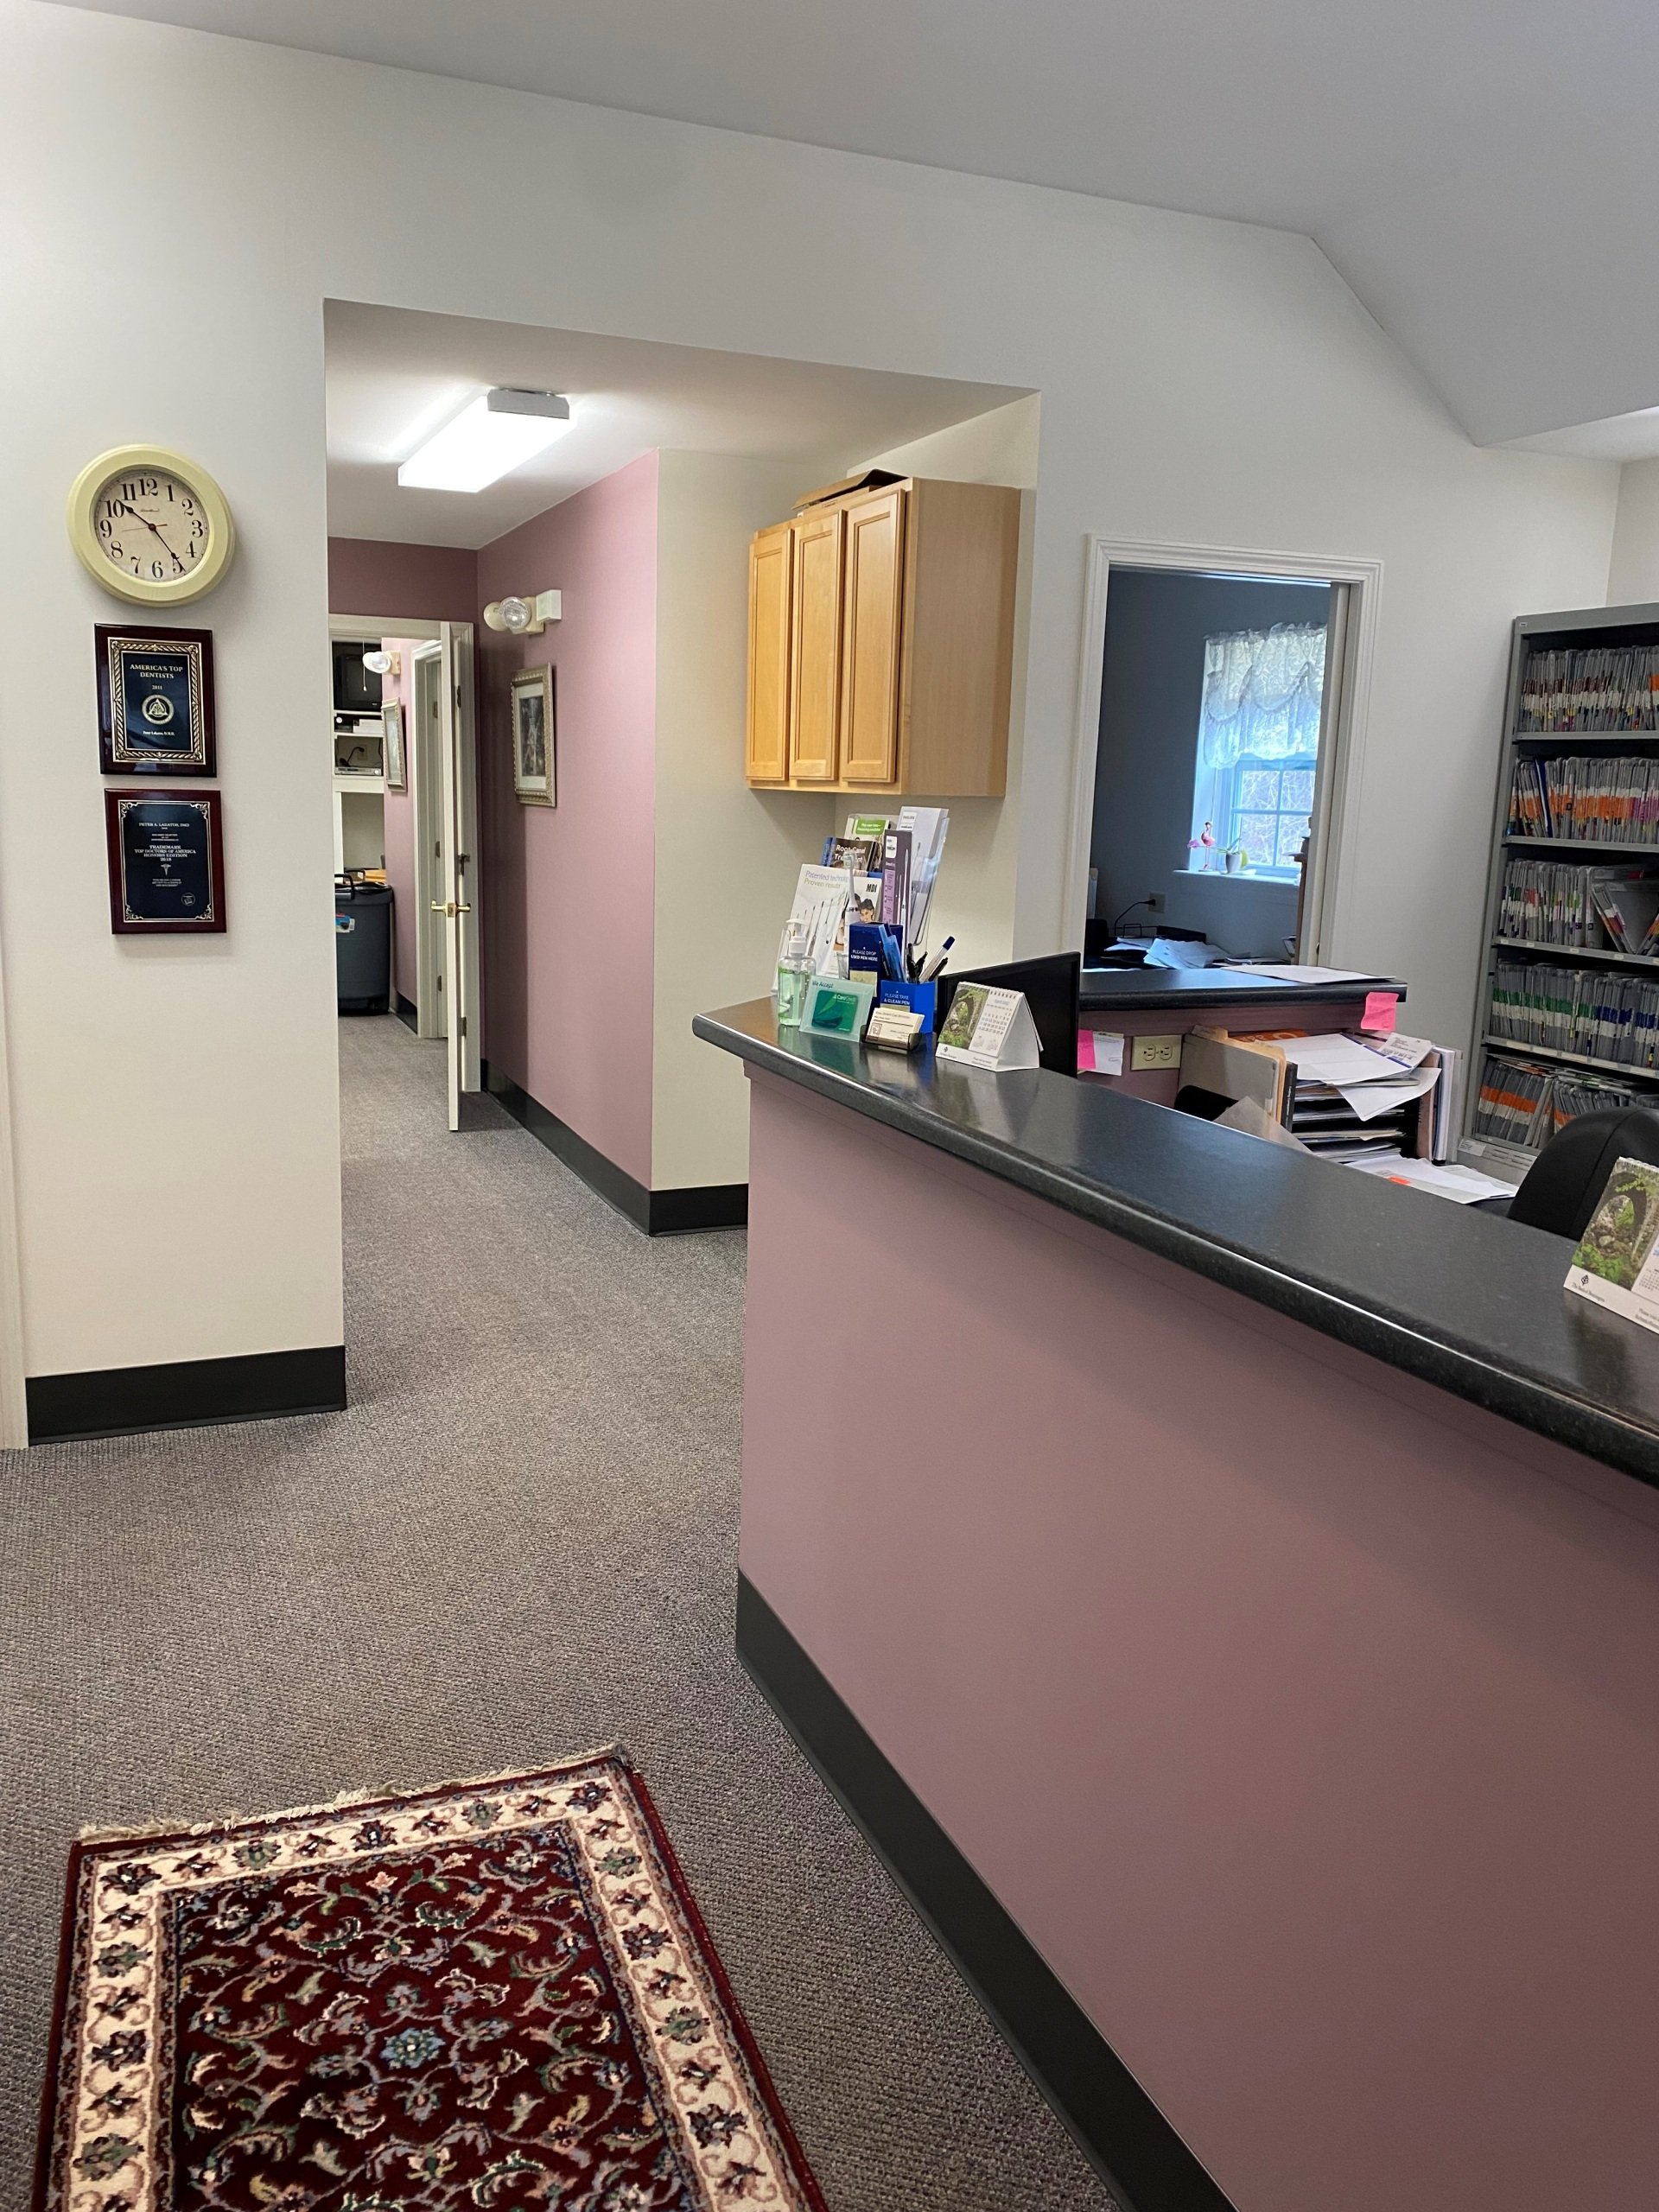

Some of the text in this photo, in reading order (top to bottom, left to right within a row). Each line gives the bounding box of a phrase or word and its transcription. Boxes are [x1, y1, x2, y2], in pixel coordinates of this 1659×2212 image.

[120, 483, 137, 500] 11
[138, 478, 158, 496] 12
[165, 484, 175, 502] 1
[104, 499, 124, 518] 10
[181, 498, 194, 517] 2
[99, 519, 112, 538] 9
[191, 519, 203, 537] 3
[110, 540, 124, 559] 8
[185, 540, 197, 558] 4
[130, 556, 142, 574] 7
[151, 560, 163, 579] 6
[172, 555, 184, 574] 5
[804, 878, 824, 887] Proven
[805, 870, 830, 880] Patented
